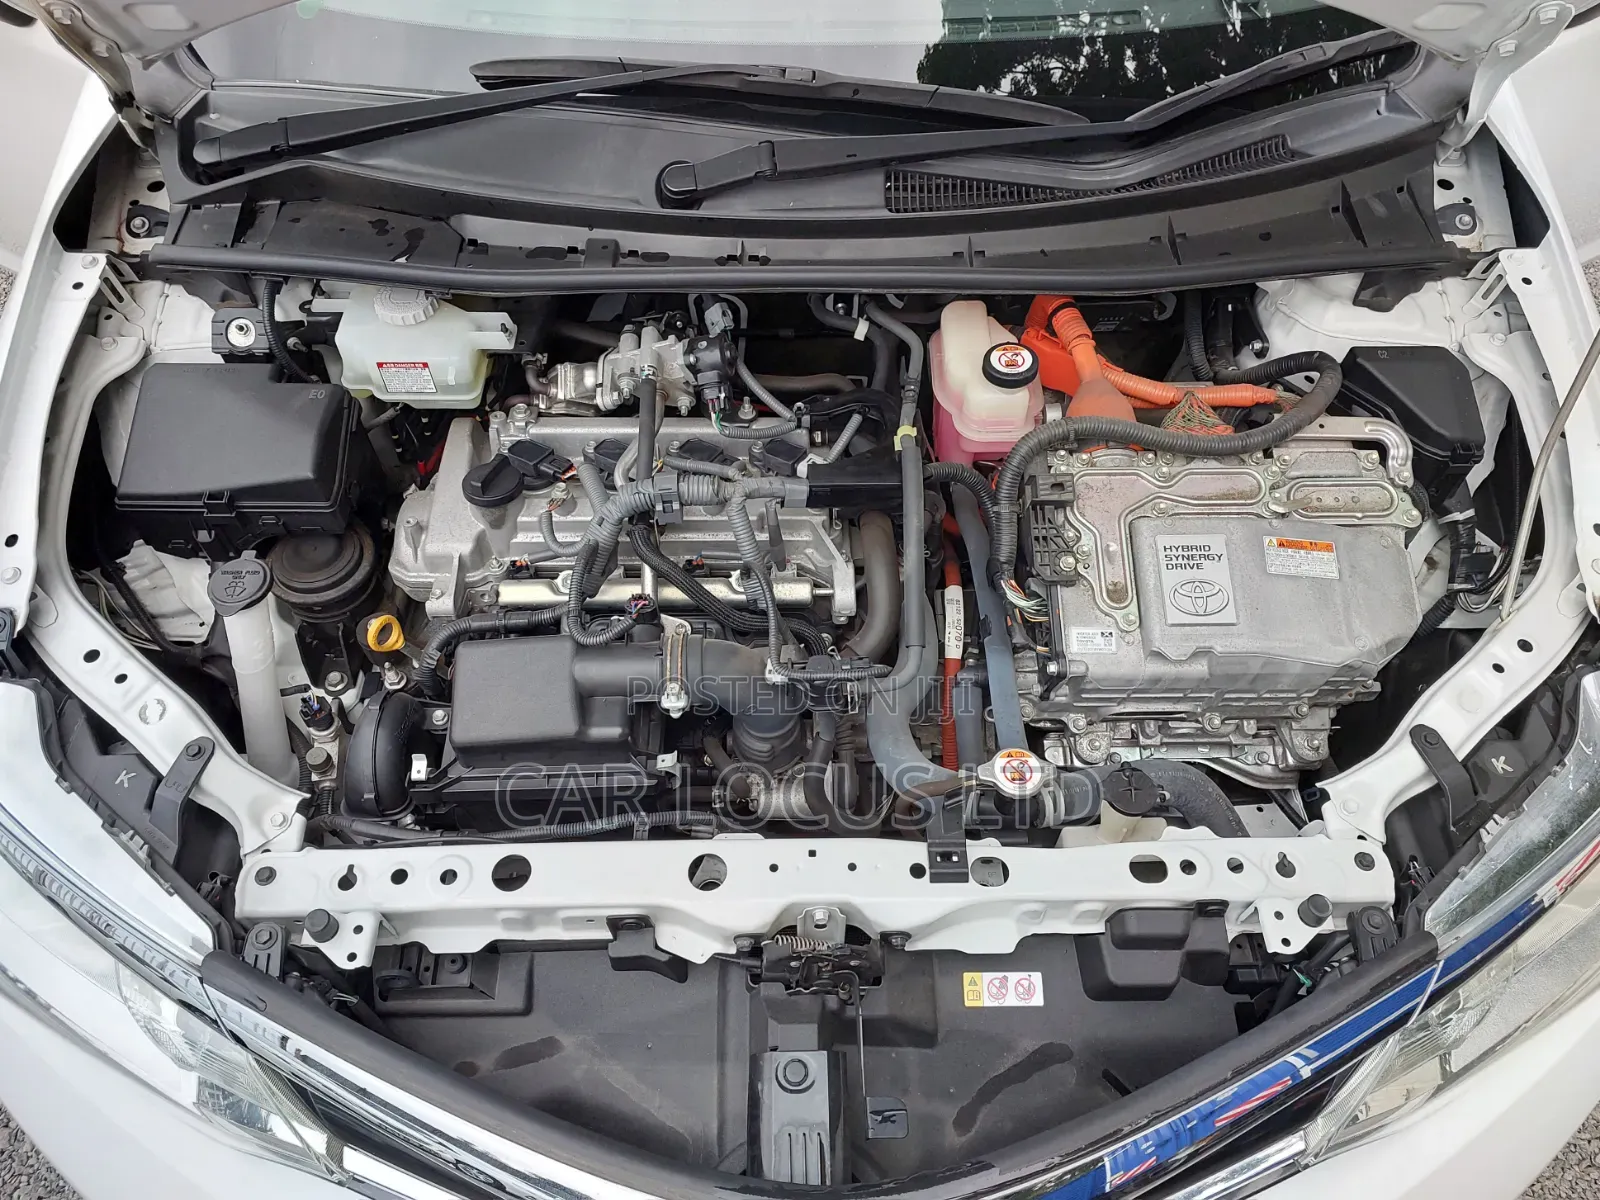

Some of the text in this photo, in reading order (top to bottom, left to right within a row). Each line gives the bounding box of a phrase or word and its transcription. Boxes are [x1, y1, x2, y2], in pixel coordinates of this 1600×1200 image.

[1163, 544, 1211, 552] HYBRID
[1164, 553, 1223, 562] SYNERGY
[1166, 562, 1204, 570] DRIVE
[1490, 755, 1514, 774] K
[114, 769, 137, 788] K
